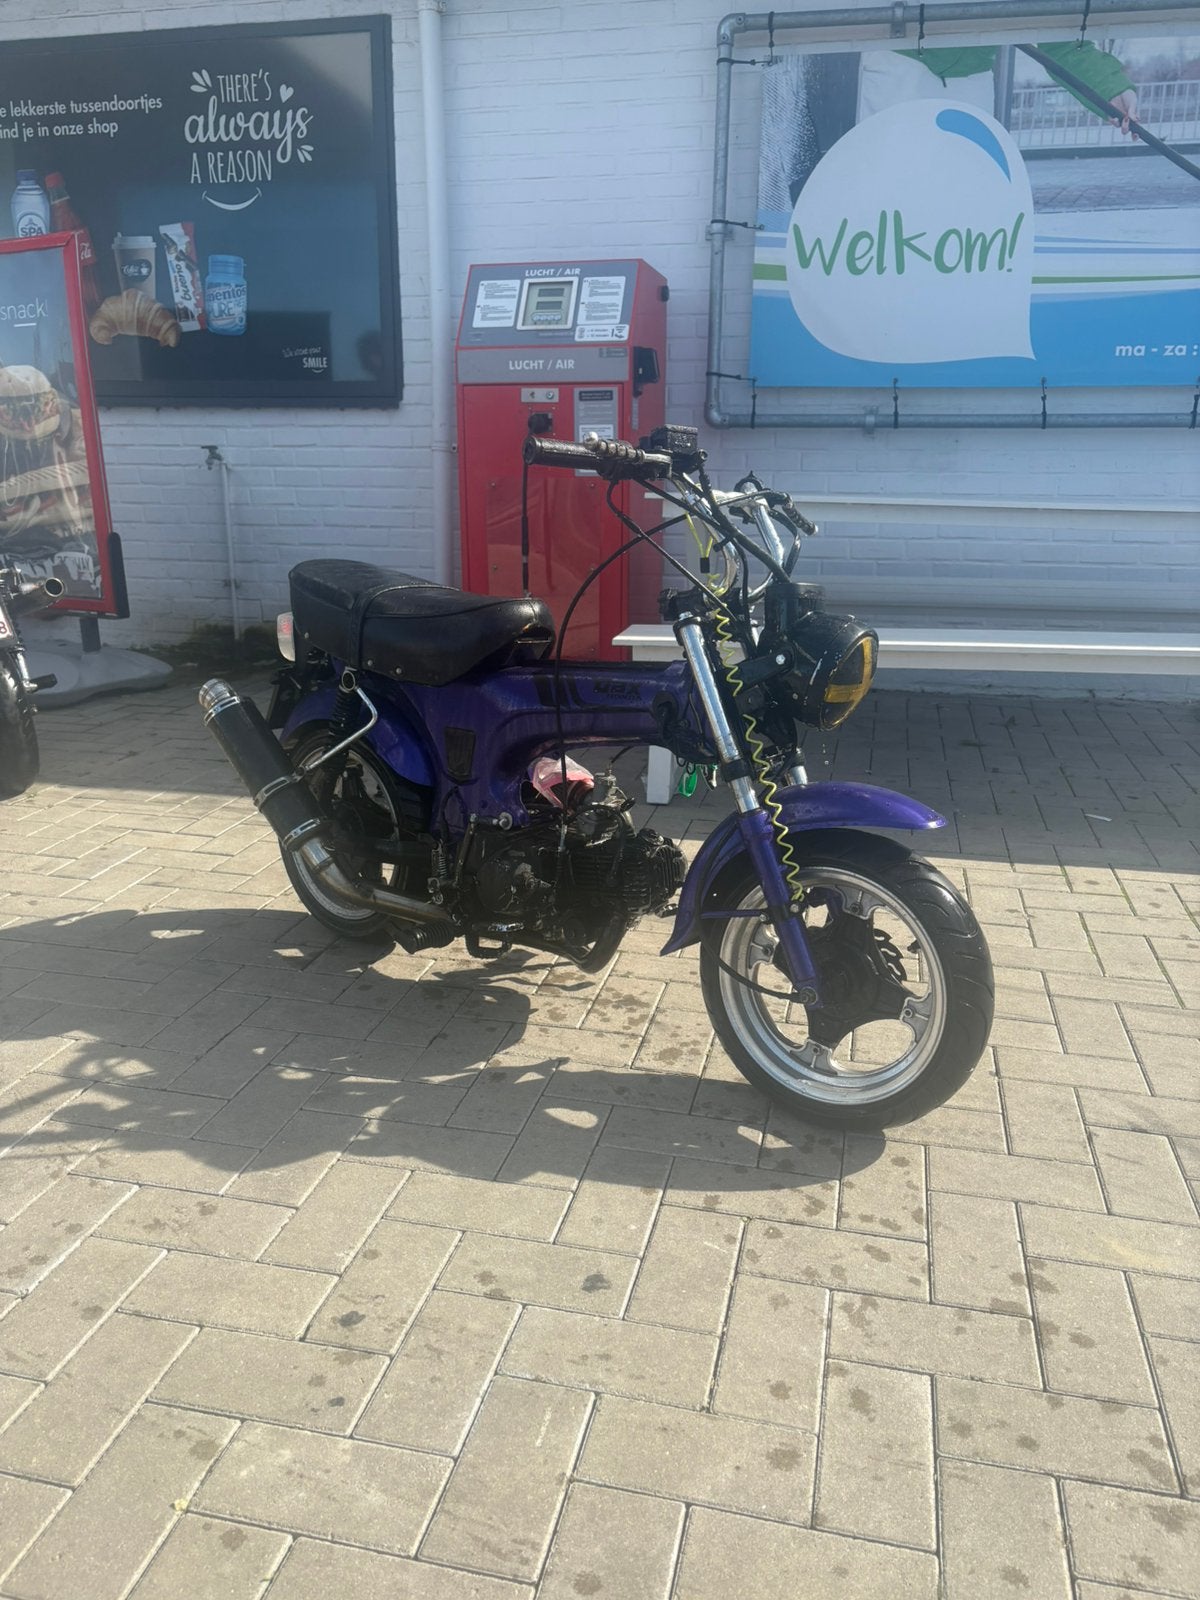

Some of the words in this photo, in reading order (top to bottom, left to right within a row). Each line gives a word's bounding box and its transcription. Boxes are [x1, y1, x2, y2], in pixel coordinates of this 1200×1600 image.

[217, 69, 271, 103] THERE'S
[10, 99, 66, 118] lekkerste
[70, 94, 163, 114] tussendoortjes
[22, 122, 34, 142] je
[37, 121, 49, 137] in
[53, 123, 83, 136] onze
[87, 117, 119, 138] shop
[184, 96, 314, 164] always
[190, 152, 202, 184] A
[207, 149, 273, 183] REASON
[20, 226, 44, 237] SPA
[792, 209, 1025, 276] Welkom!
[176, 263, 192, 301] bueno
[525, 268, 555, 277] LUCHT
[564, 267, 581, 276] AIR
[207, 286, 247, 302] mentos
[303, 357, 328, 368] SMILE
[1114, 344, 1146, 357] ma
[1163, 344, 1187, 356] za
[508, 359, 544, 370] LUCHT
[555, 359, 575, 370] AIR
